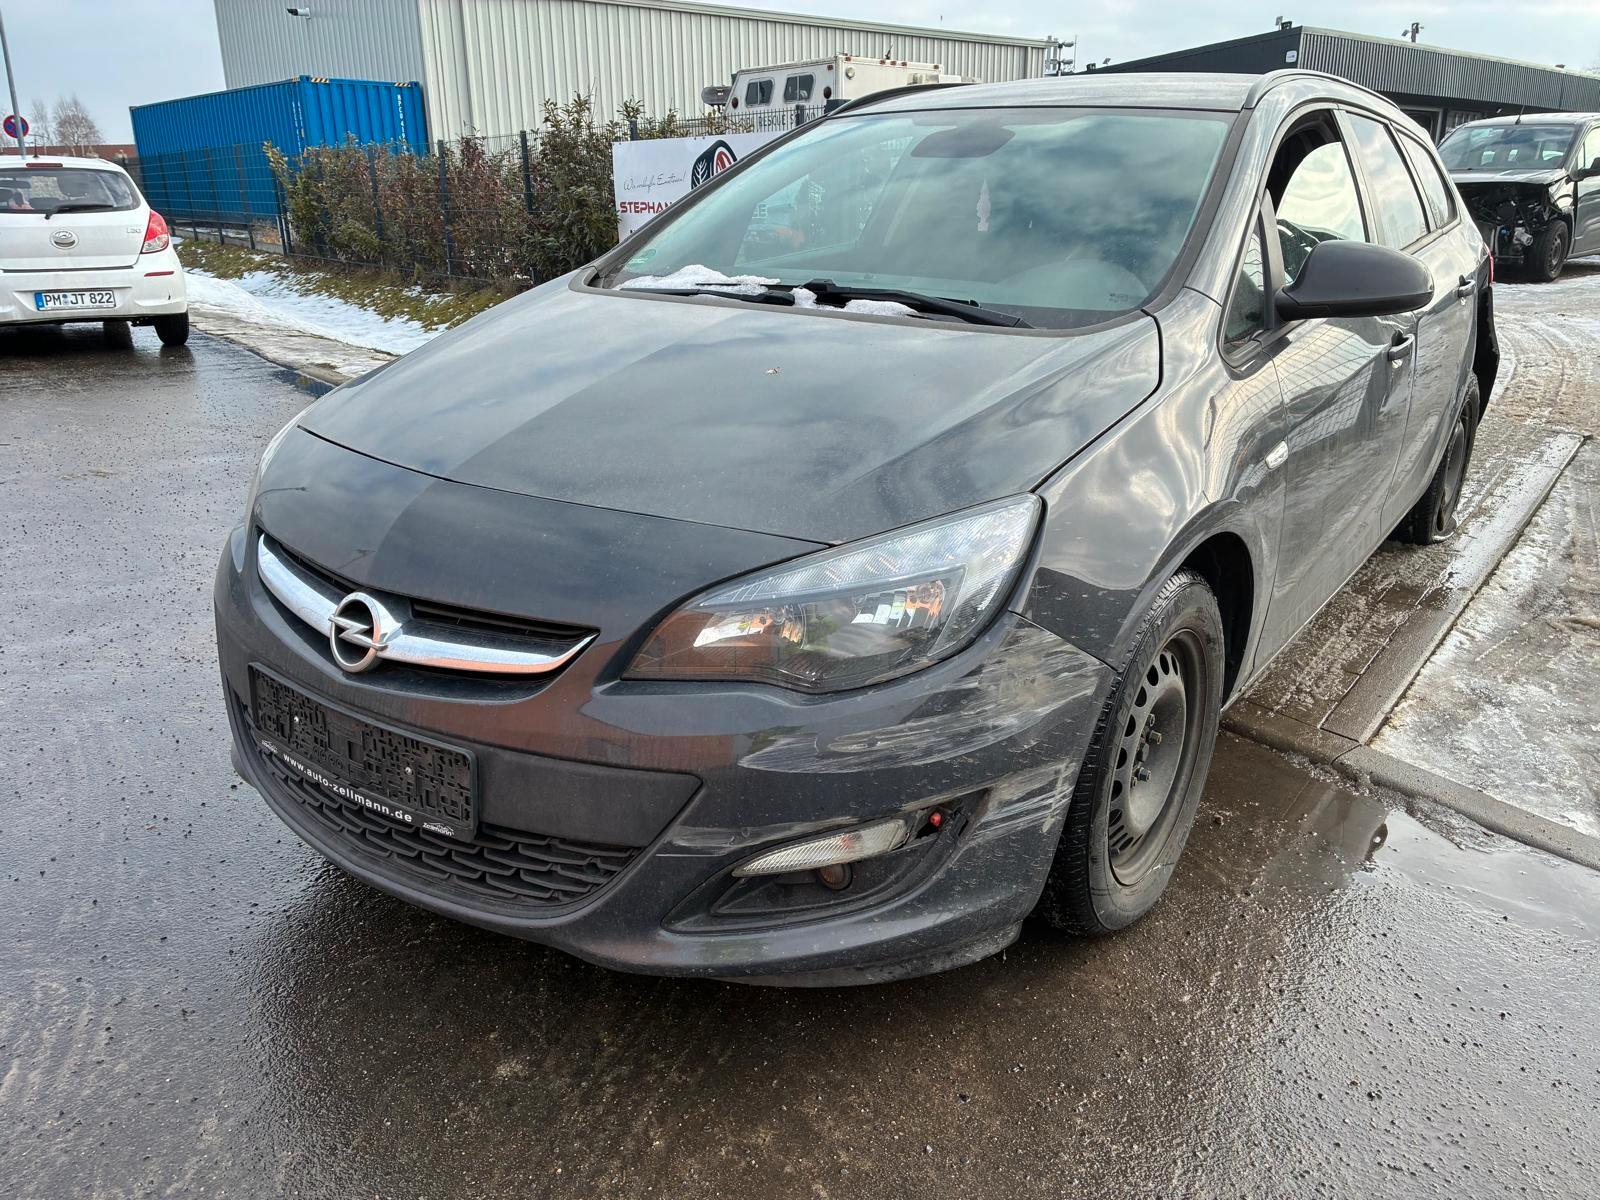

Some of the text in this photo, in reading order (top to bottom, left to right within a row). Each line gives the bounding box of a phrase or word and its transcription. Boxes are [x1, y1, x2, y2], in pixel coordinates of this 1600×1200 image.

[43, 292, 114, 306] PM JT 822
[283, 753, 412, 822] www.auto-zellmann.de
